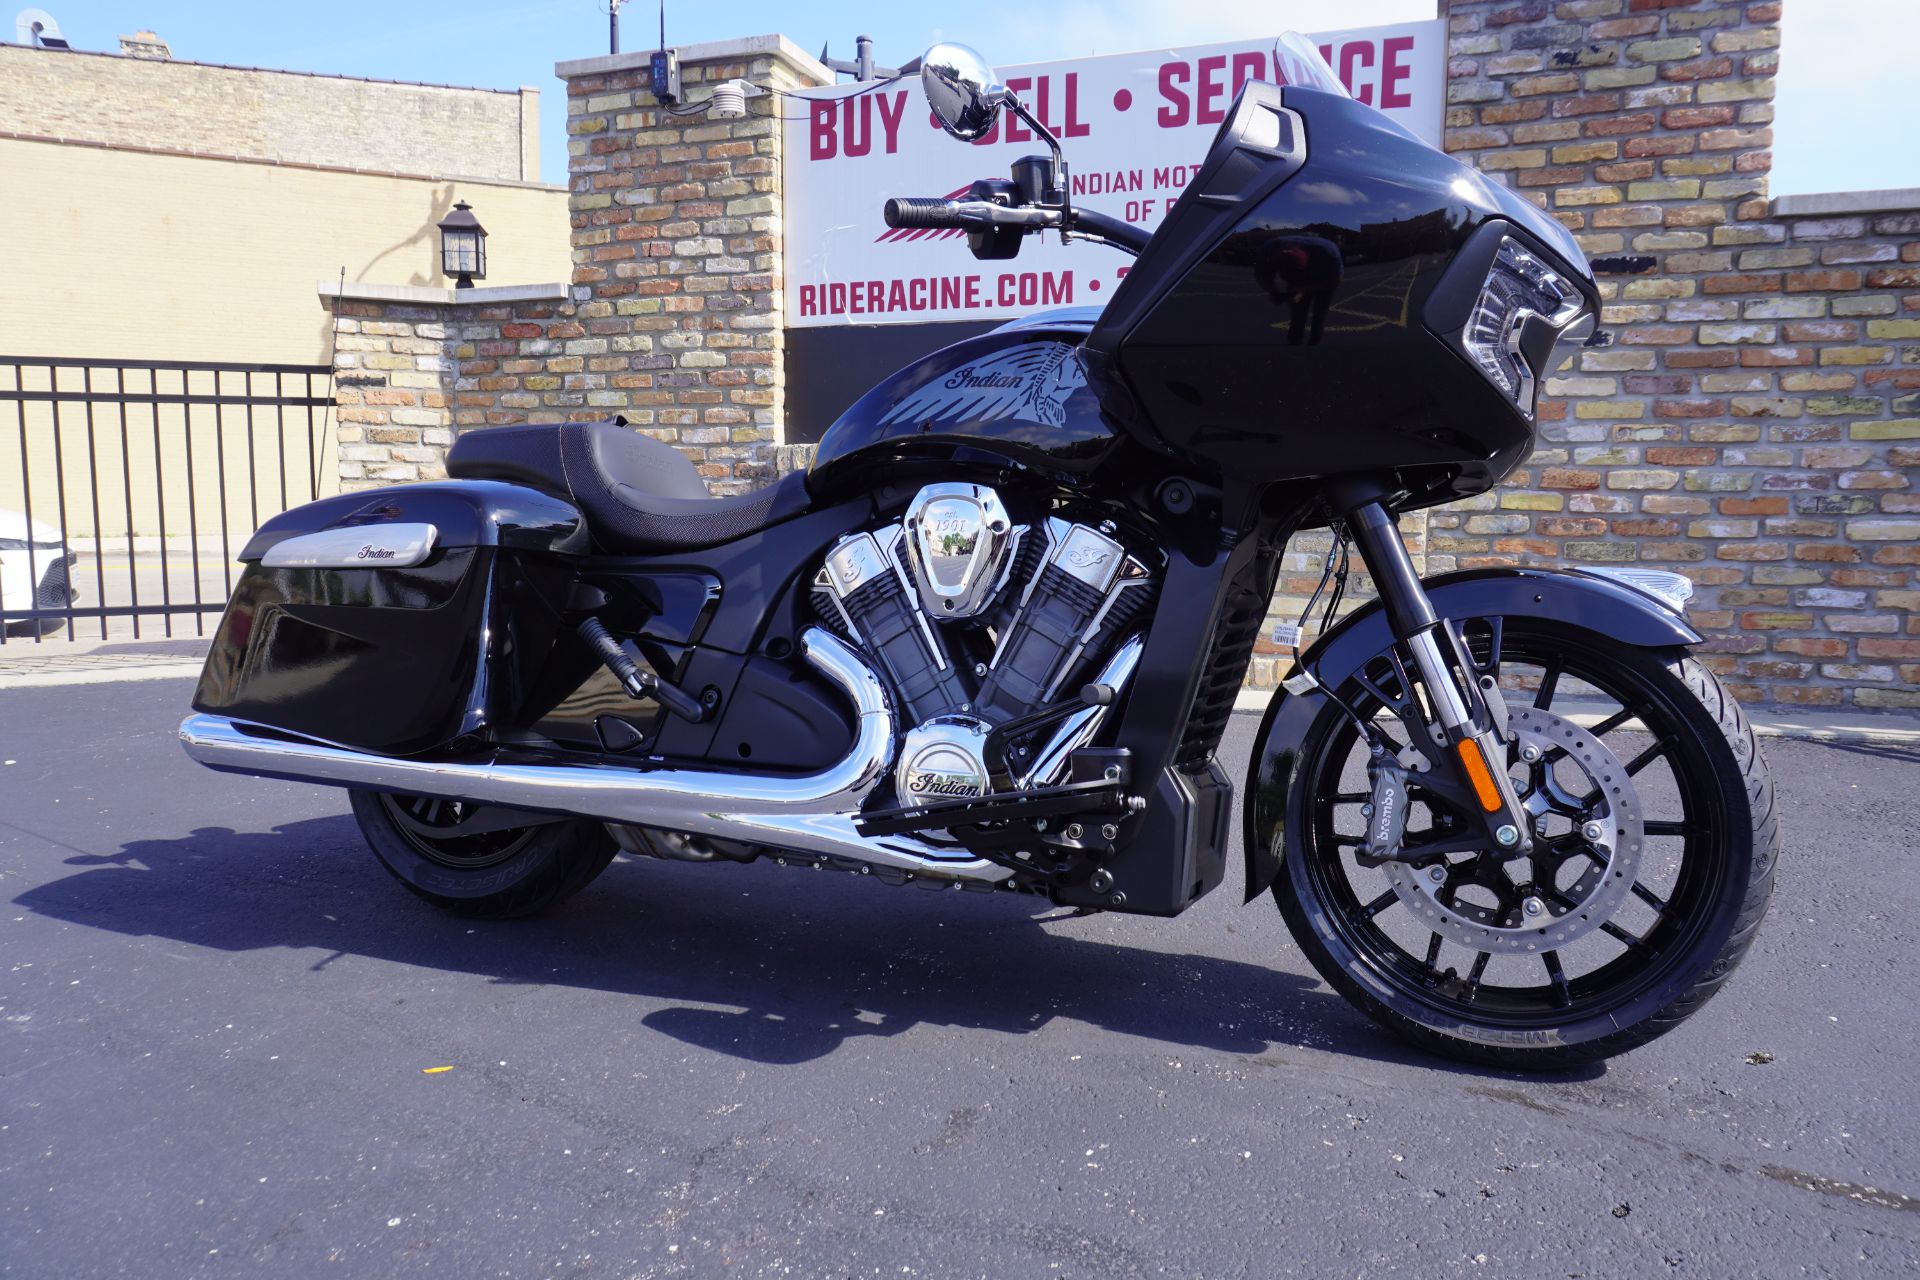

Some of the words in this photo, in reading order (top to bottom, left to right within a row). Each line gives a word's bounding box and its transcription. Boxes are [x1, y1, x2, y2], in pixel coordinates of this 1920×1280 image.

[810, 90, 908, 161] BUY
[971, 72, 1090, 146] ELL
[1125, 200, 1155, 222] OF
[800, 271, 1073, 316] RIDERACINE.COM
[944, 366, 1025, 390] Indian
[357, 544, 396, 559] Indian
[910, 773, 979, 798] Indian
[1377, 788, 1394, 841] brembo
